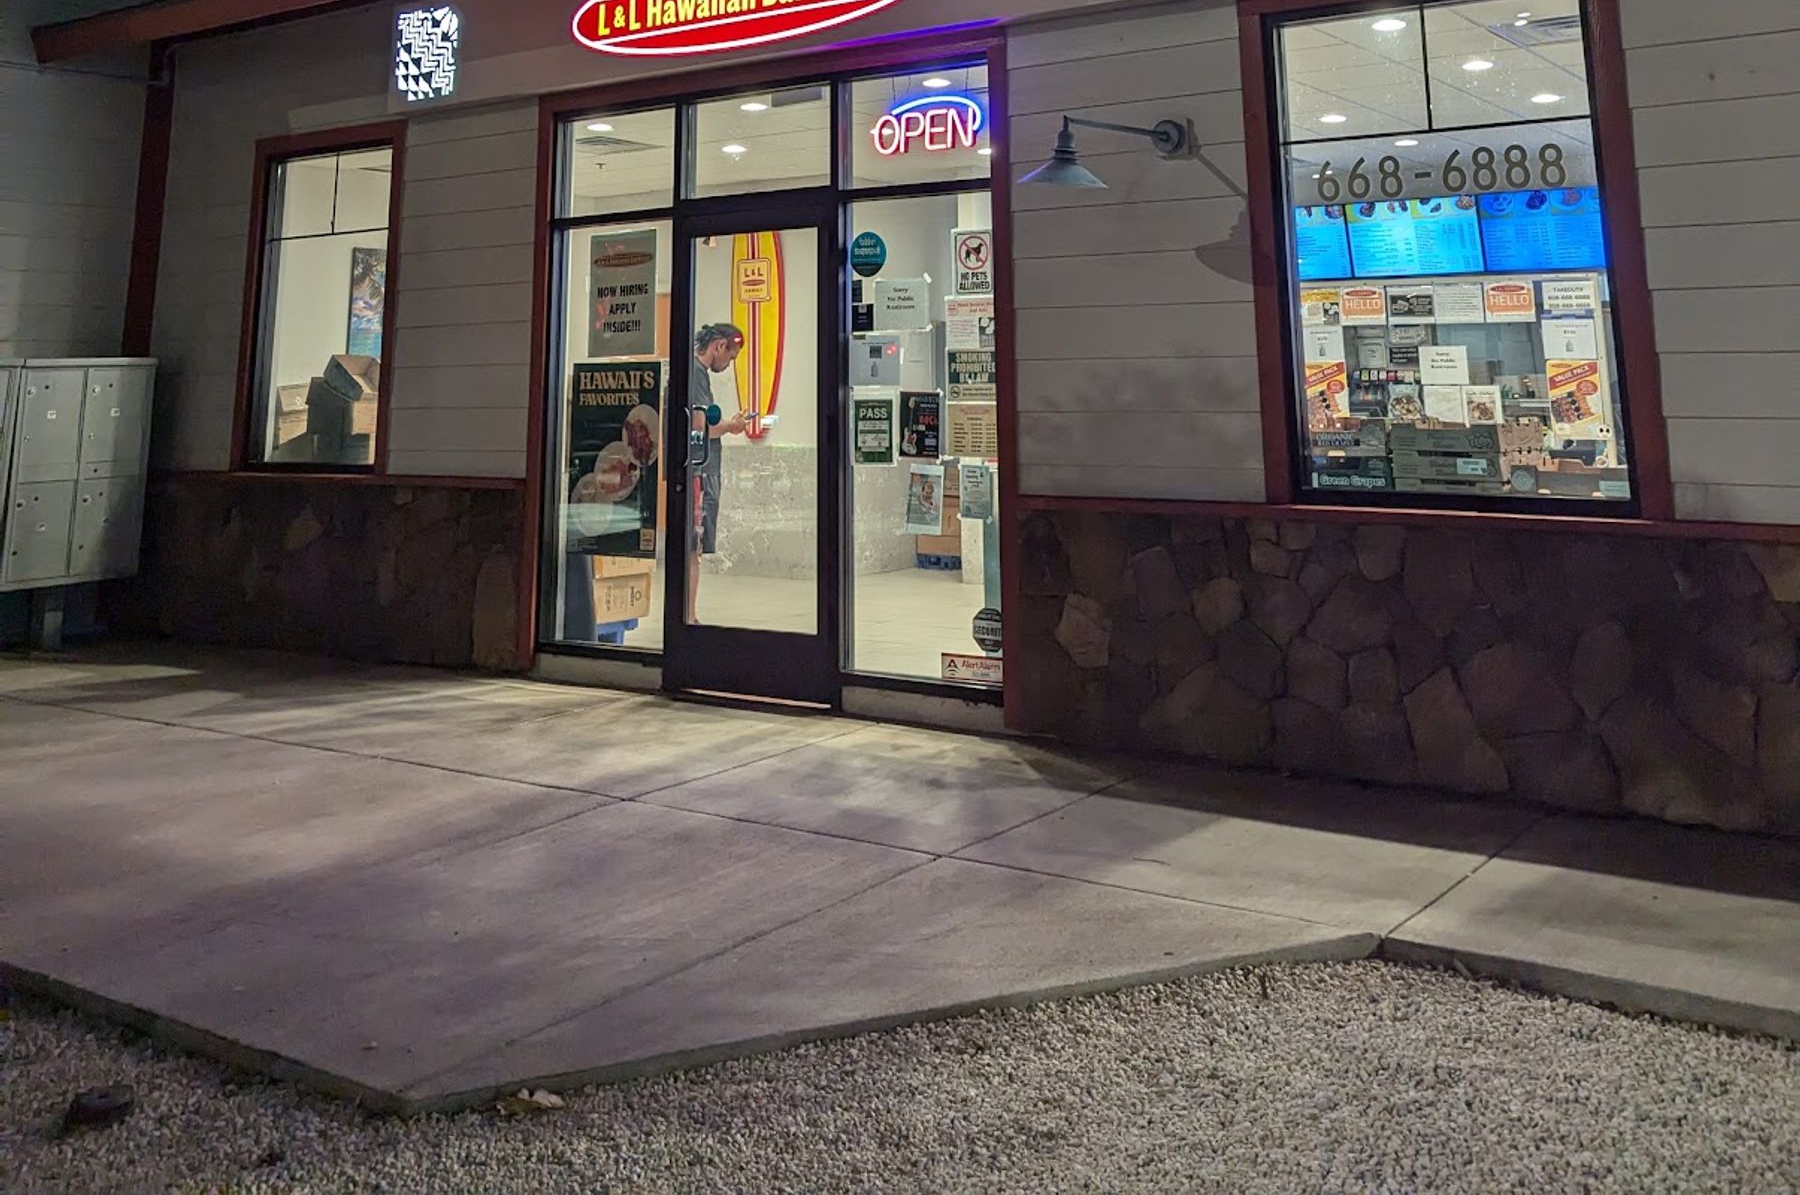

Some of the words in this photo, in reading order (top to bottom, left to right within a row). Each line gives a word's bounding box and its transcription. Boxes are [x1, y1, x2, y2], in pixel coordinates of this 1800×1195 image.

[872, 106, 976, 156] OPEN
[1317, 143, 1566, 202] 668-6888
[960, 271, 970, 281] NO
[972, 271, 989, 281] PETS
[597, 285, 617, 298] NOW
[619, 283, 649, 297] HIRING
[959, 280, 990, 291] ALLOWED
[1345, 298, 1381, 310] HELLO
[1489, 295, 1530, 306] HELLO
[608, 302, 637, 315] APPLY
[603, 319, 641, 334] INSIDE!!!
[955, 353, 991, 362] SMOKING
[579, 392, 640, 406] FAVORITES
[859, 407, 888, 419] PASS
[1319, 474, 1349, 485] Green
[1350, 475, 1386, 488] Grapes
[962, 660, 979, 668] Alert
